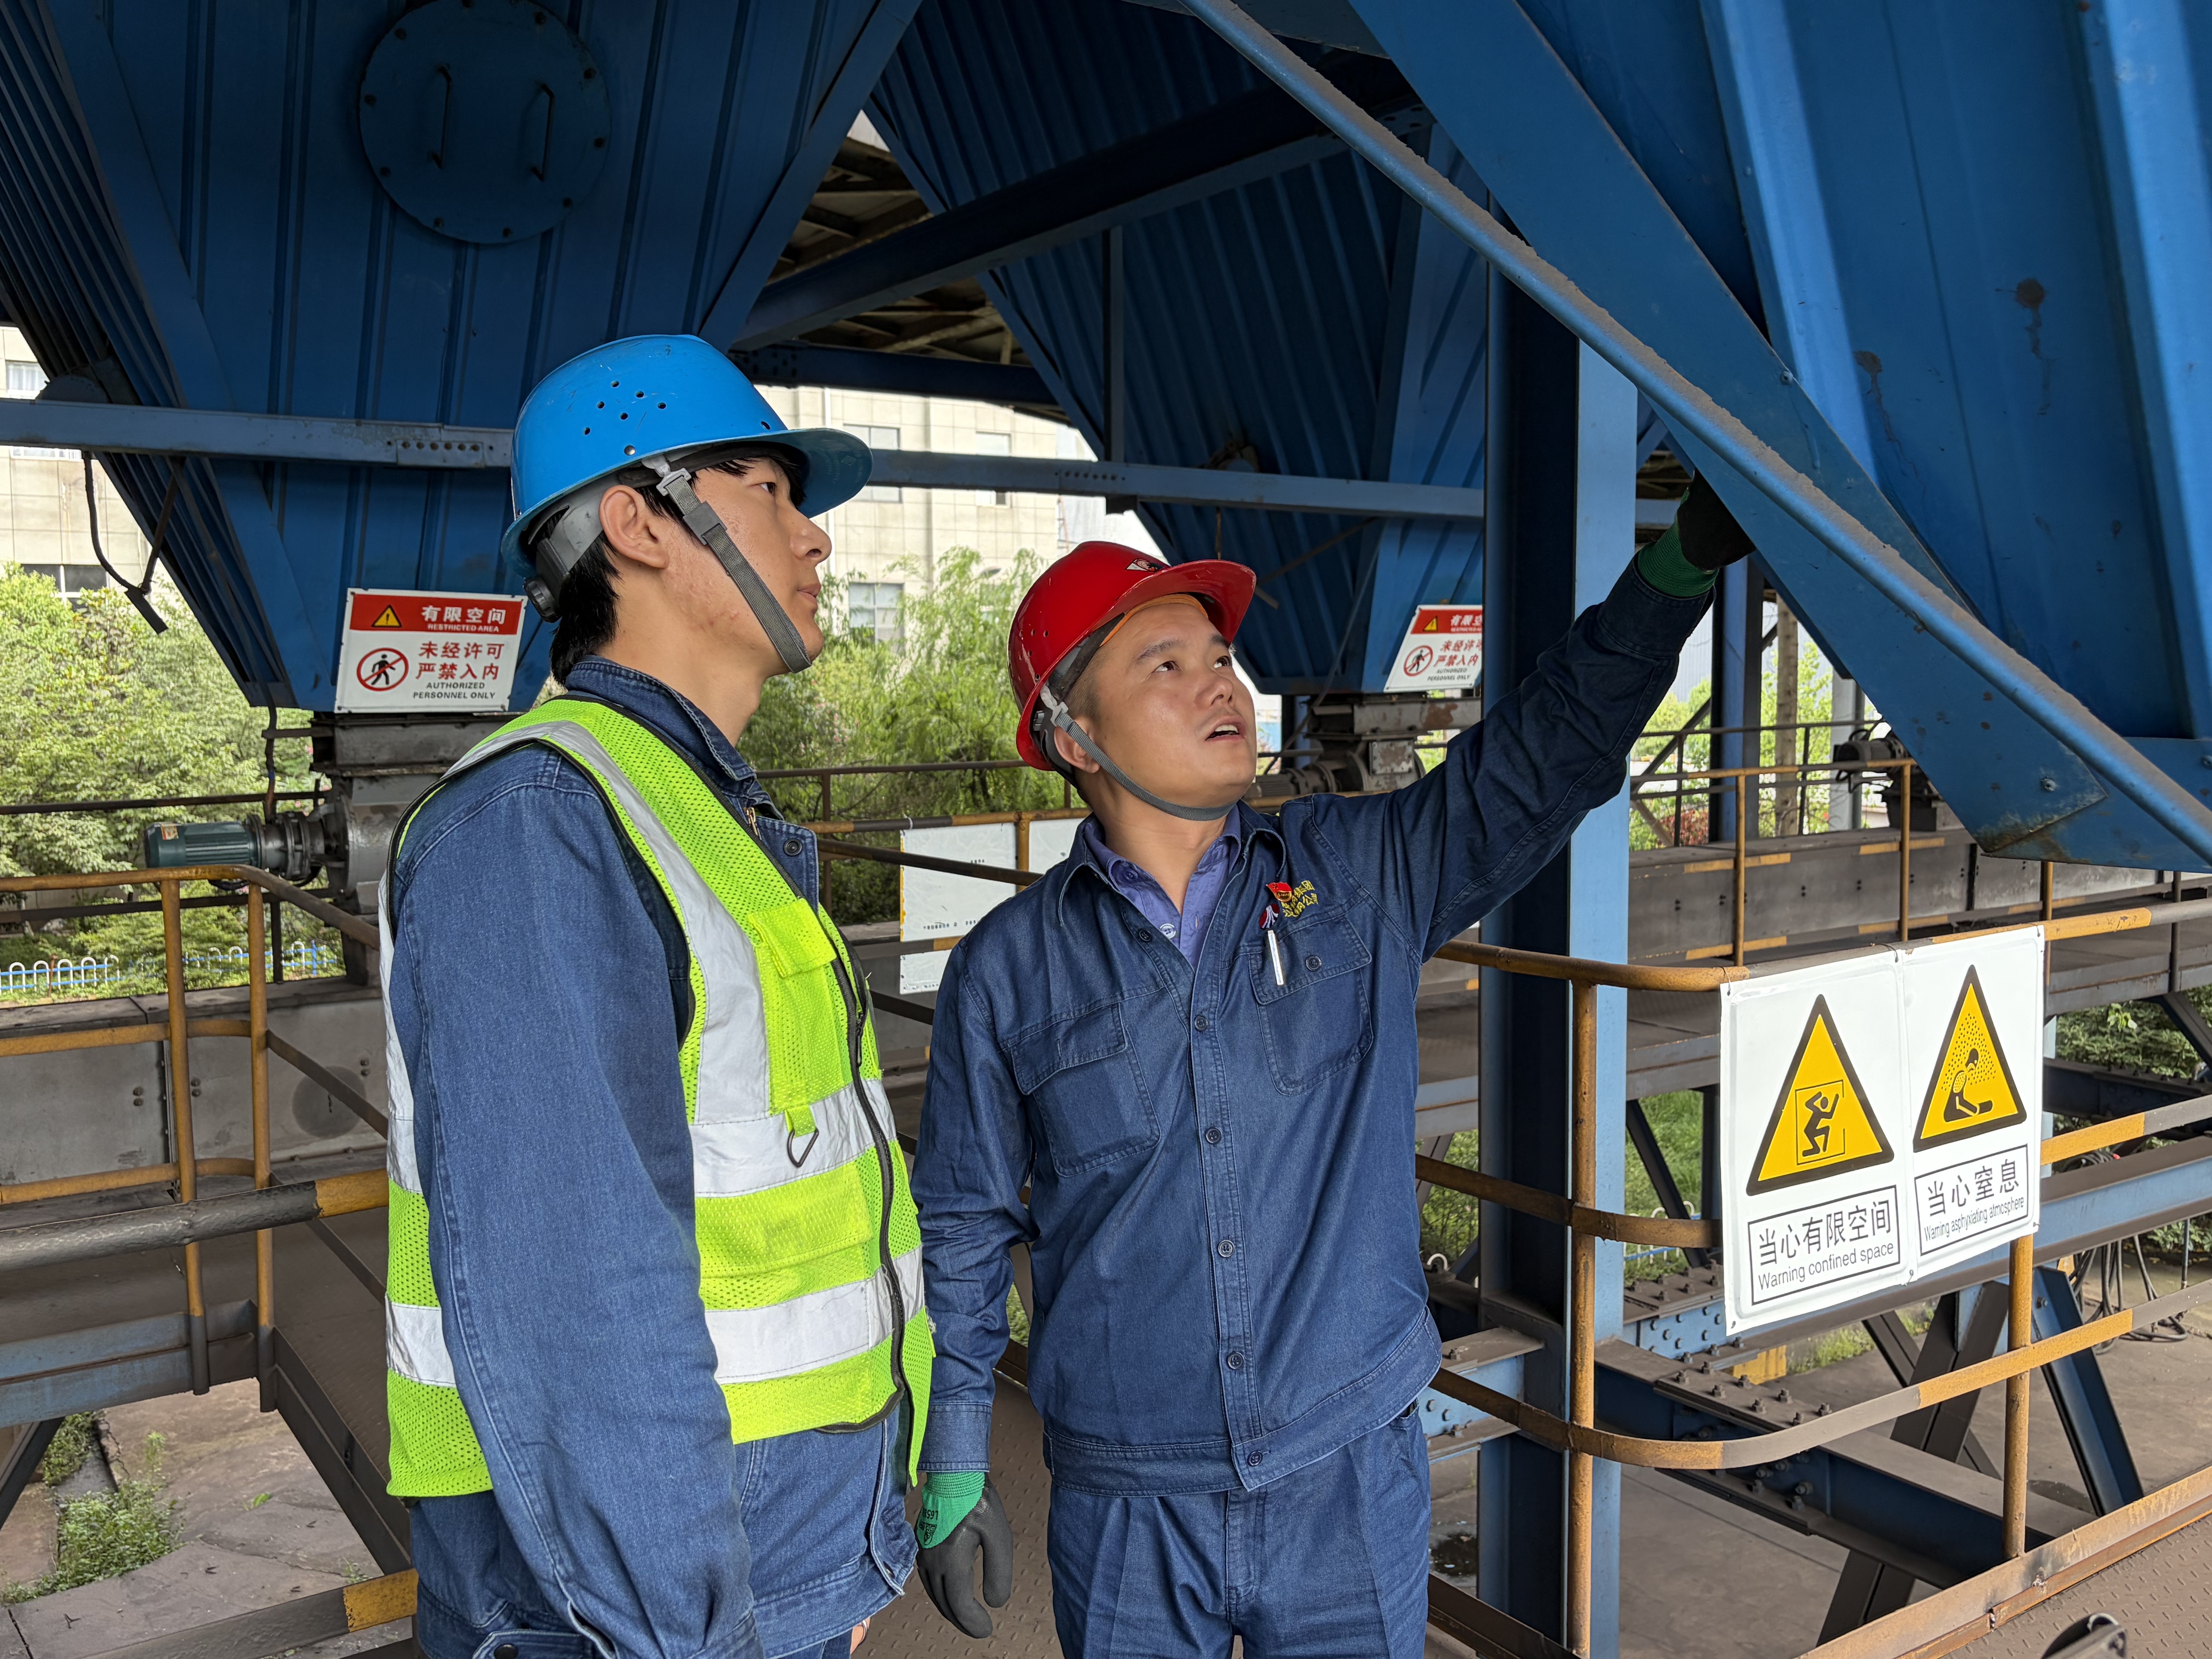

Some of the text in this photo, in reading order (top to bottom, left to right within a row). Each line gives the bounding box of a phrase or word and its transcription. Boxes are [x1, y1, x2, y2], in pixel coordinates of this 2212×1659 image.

[421, 605, 506, 625] 有限空间
[428, 623, 477, 632] RESTRICTED
[419, 641, 505, 659] 未经许可
[1434, 653, 1479, 666] 严禁入内
[416, 663, 499, 680] 严禁入内
[1928, 1159, 2019, 1217] 当心窒息
[1924, 1197, 2024, 1242] Warning asphyxiating atmosphere
[1759, 1199, 1891, 1266] 当心有限空间
[1758, 1243, 1894, 1290] Warning confined space
